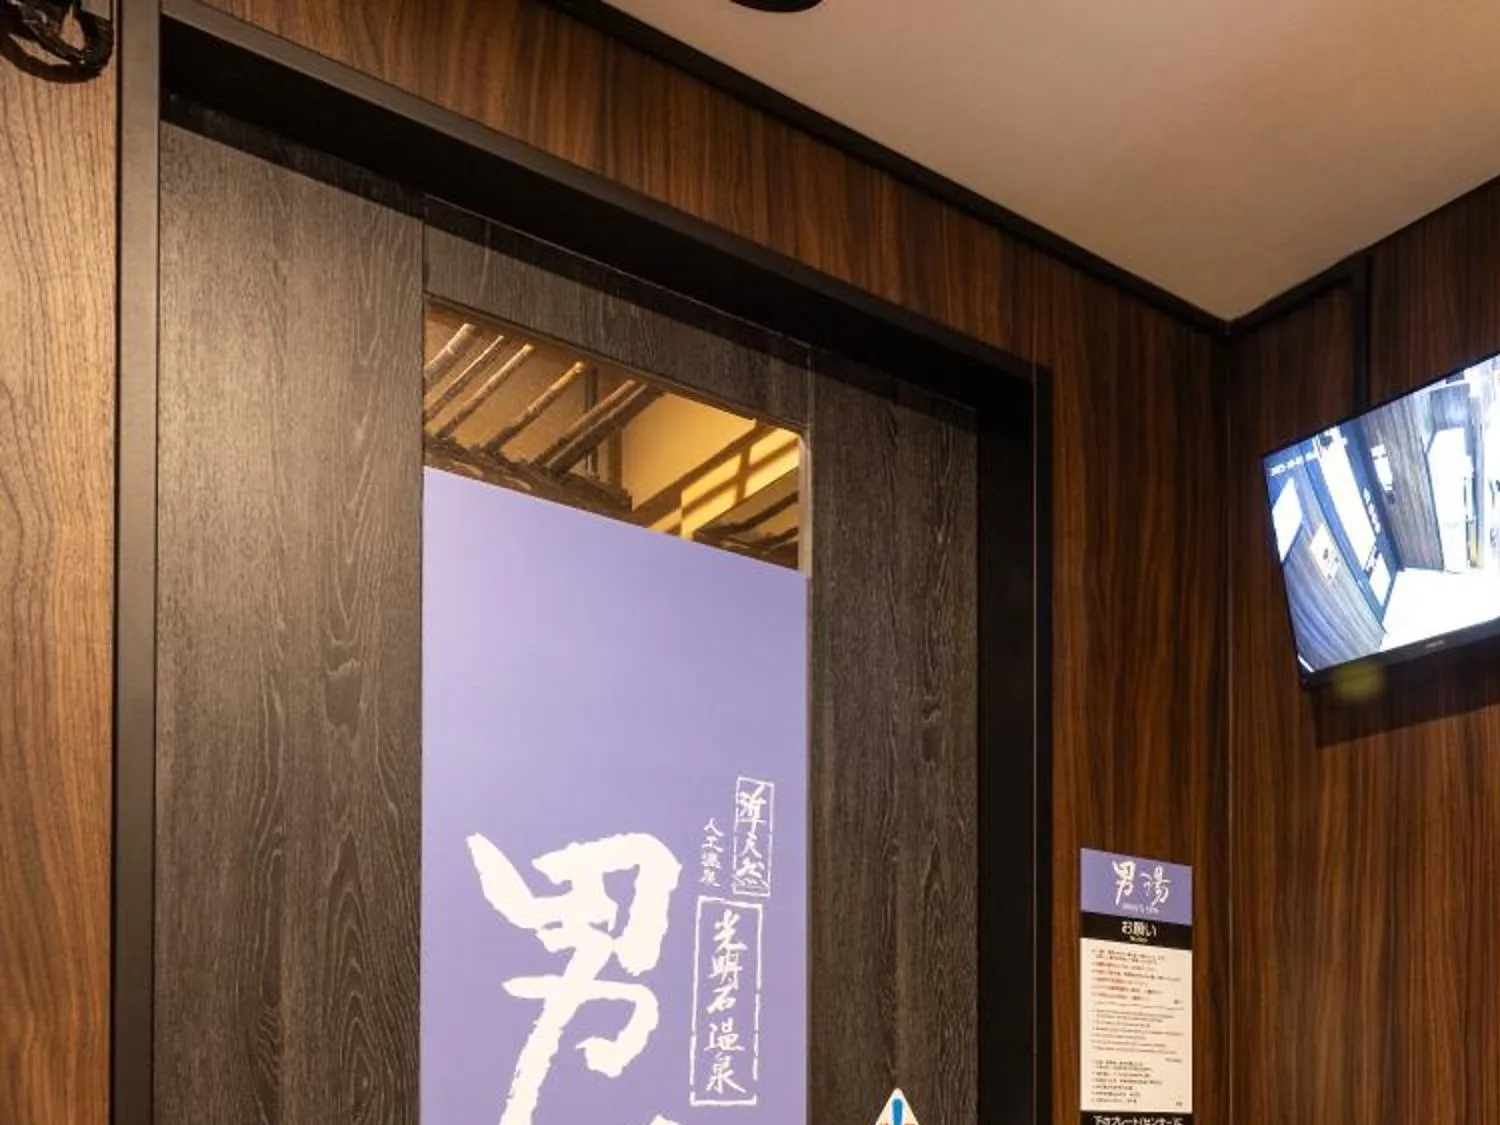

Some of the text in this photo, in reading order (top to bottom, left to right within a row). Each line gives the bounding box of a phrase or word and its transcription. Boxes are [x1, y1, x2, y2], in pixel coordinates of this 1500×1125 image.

[1112, 860, 1171, 907] 男湯
[705, 909, 749, 1095] 光明石温泉
